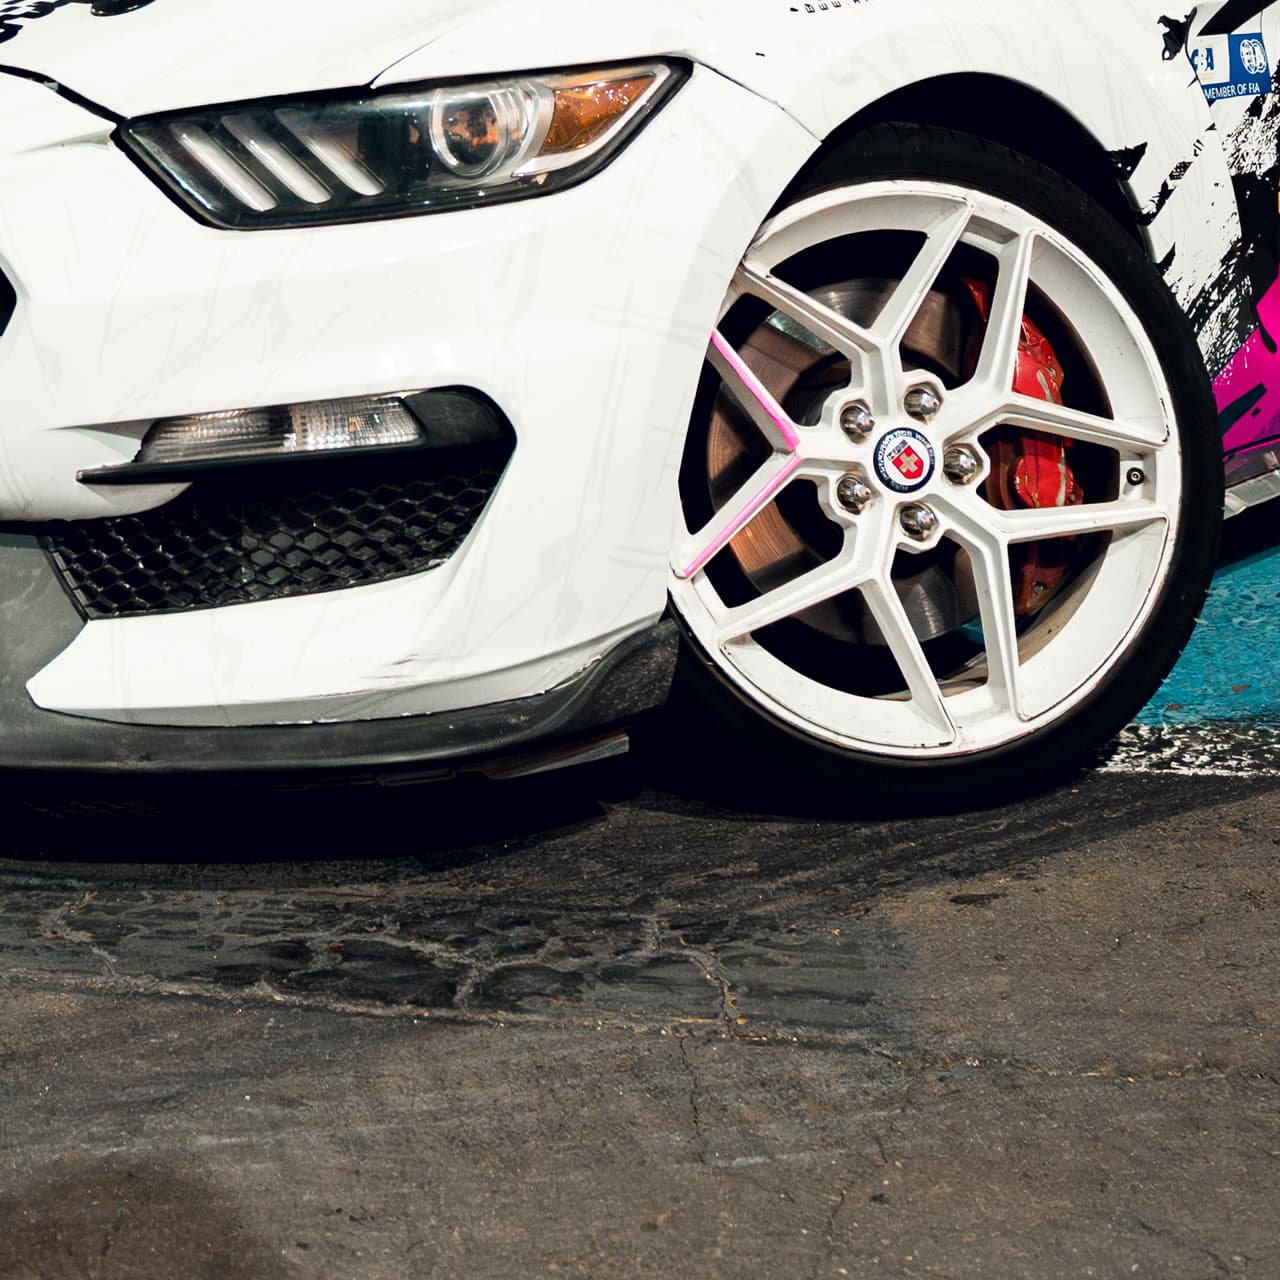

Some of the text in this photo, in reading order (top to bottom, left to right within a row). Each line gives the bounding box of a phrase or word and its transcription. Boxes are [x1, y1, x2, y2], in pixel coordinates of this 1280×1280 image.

[1204, 82, 1261, 99] MEMBER OF FIA
